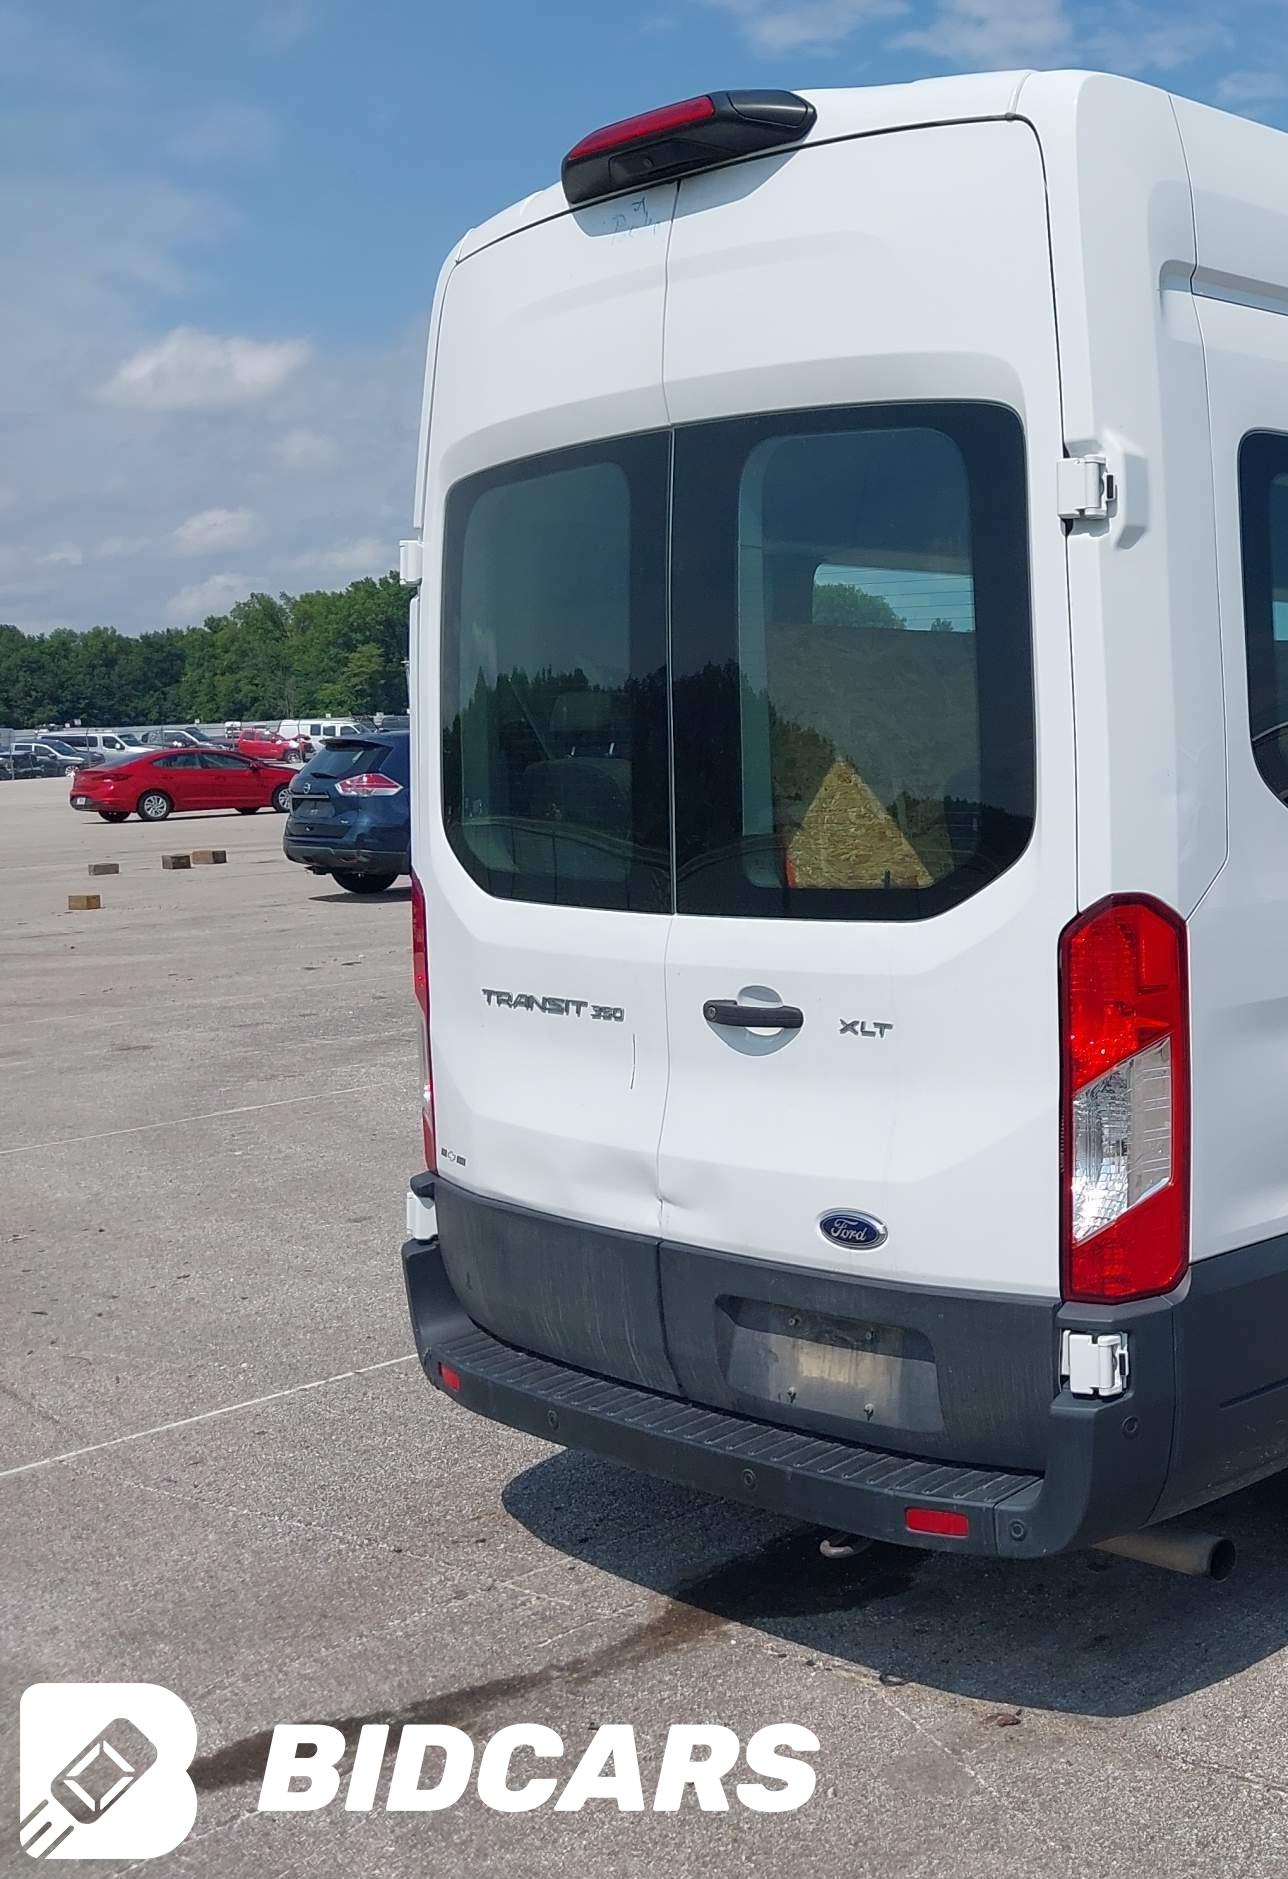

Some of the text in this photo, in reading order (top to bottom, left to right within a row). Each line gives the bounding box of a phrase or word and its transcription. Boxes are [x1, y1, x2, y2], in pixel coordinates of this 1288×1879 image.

[481, 988, 589, 1018] TRANSIT
[839, 1018, 894, 1039] XLT
[830, 1218, 868, 1241] Ford
